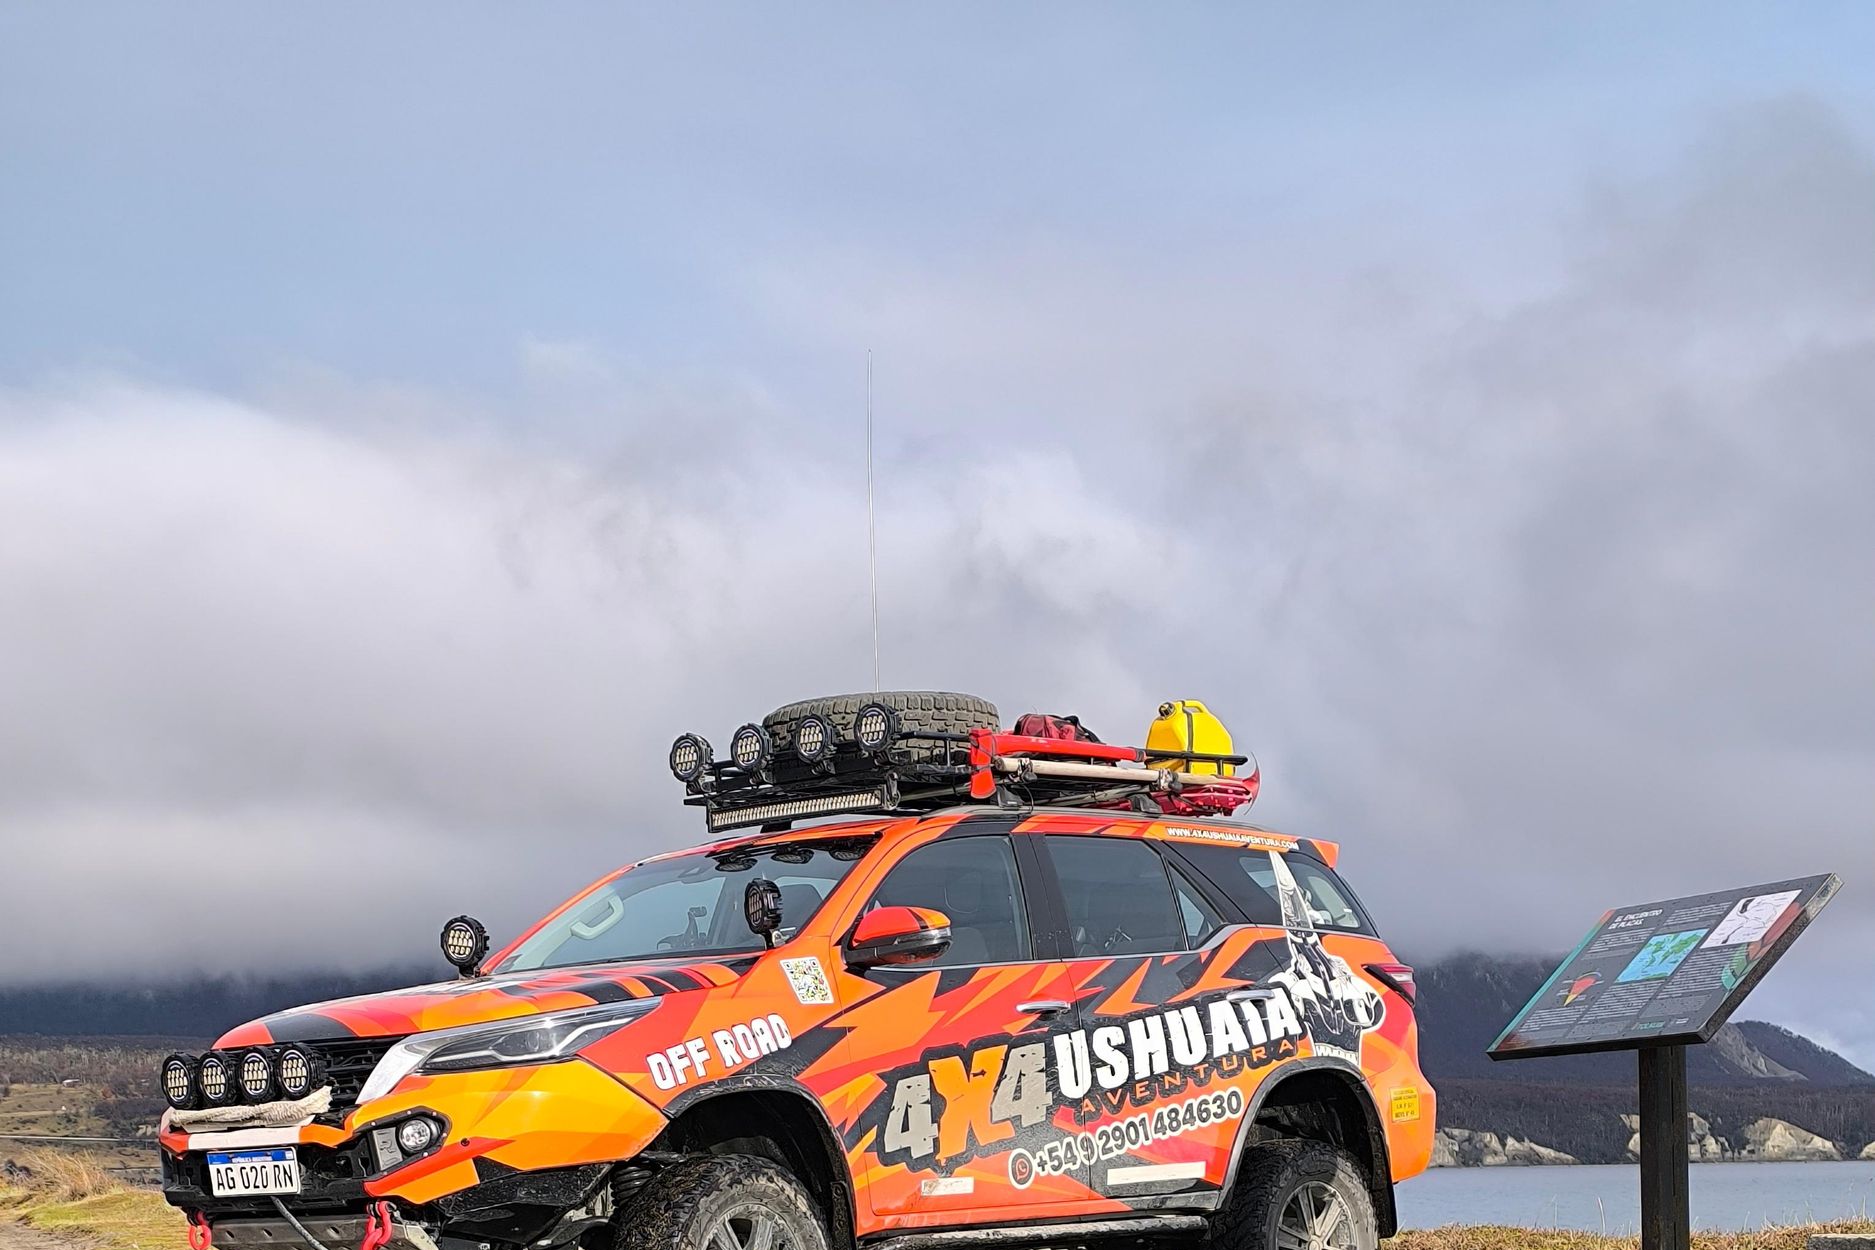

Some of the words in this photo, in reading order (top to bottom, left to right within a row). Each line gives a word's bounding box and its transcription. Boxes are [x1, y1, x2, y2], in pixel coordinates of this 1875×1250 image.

[646, 1037, 711, 1091] OFF
[712, 1013, 792, 1068] ROAD
[884, 1043, 1053, 1166] 4X4
[1053, 987, 1302, 1099] USHUAIA
[1081, 1039, 1294, 1116] AVENTURA
[1098, 1116, 1150, 1155] 2901
[1154, 1089, 1242, 1137] 484630
[216, 1166, 236, 1191] AG
[240, 1165, 269, 1189] 020
[273, 1164, 294, 1188] RN
